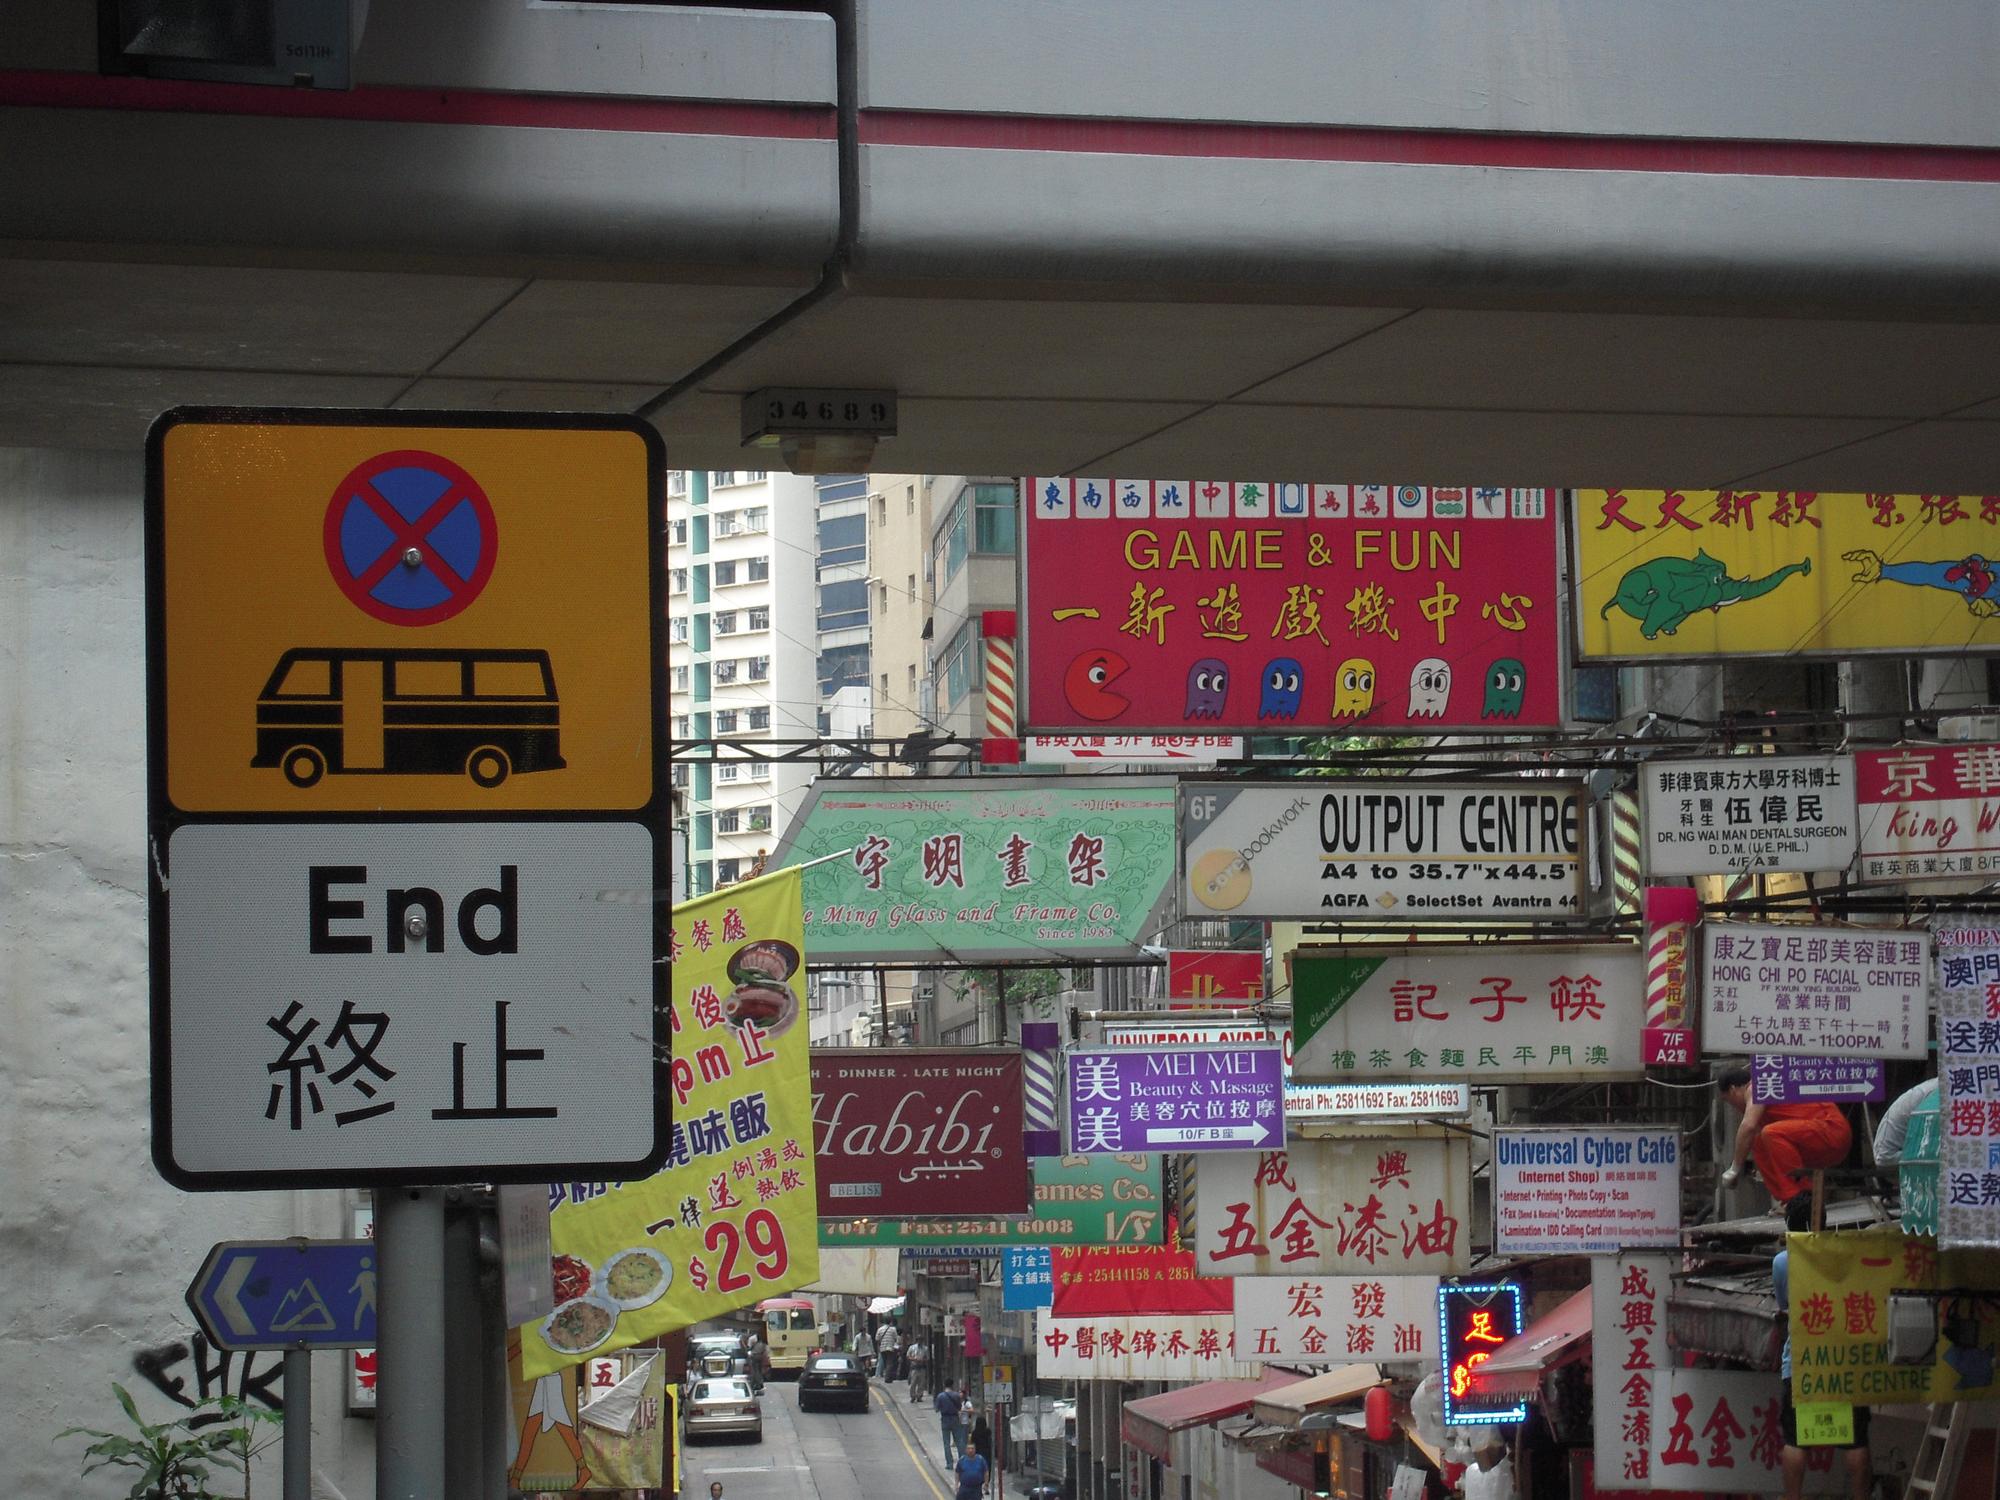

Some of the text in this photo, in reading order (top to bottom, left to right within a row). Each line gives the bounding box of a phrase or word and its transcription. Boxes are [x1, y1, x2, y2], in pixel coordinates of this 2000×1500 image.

[286, 44, 334, 58] HILIPS
[769, 401, 887, 423] 34689
[1124, 529, 1462, 571] GAME & FUN
[1051, 581, 1535, 647] 一新遊戲機中心
[1660, 768, 1841, 793] 菲律賓東方大學牙科博士
[1190, 795, 1216, 820] 6F
[1725, 794, 1823, 826] 伍偉民
[1320, 793, 1579, 853] OUTPUT CENTRE
[1658, 826, 1847, 843] DR. NG WAI MAN DENTAL SURGEON
[1886, 803, 1959, 849] King
[1322, 863, 1357, 880] A4
[1371, 864, 1398, 880] to
[1870, 856, 1973, 876] 群英商業大廈
[309, 865, 518, 955] End
[1322, 894, 1370, 908] AGFA
[1407, 893, 1482, 908] SelectSet
[1493, 894, 1551, 908] Avantra
[822, 905, 879, 928] Ming
[890, 904, 947, 925] Glass
[956, 902, 998, 922] and
[1014, 904, 1078, 922] Frame
[1087, 903, 1121, 921] Co.
[1037, 926, 1114, 940] Since 1983
[1714, 935, 1921, 965] 康之寶足部美容護理
[1712, 965, 1921, 987] HONG CHI PO FACIAL CENTER
[1775, 994, 1850, 1012] 營業時間
[1735, 1015, 1890, 1034] 上午九時至下午十一時
[1663, 1032, 1684, 1046] 7/F
[1741, 1031, 1884, 1049] 9:00A.M. 11:00P.M.
[265, 1000, 558, 1130] 終止
[839, 1068, 896, 1078] DINNER
[914, 1068, 949, 1078] LATE
[957, 1067, 1004, 1077] NIGHT
[1145, 1052, 1257, 1076] MEI MEI
[1130, 1082, 1185, 1098] Beauty
[1190, 1081, 1203, 1095] &
[1210, 1079, 1274, 1097] Massage
[1129, 1099, 1276, 1122] 美容穴位按摩
[1317, 1093, 1332, 1110] Ph:
[1387, 1091, 1407, 1107] Fax:
[811, 1090, 1000, 1156] Habibi
[1178, 1130, 1206, 1140] 10/F
[1499, 1135, 1676, 1167] Universal Cyber Café
[1518, 1170, 1565, 1183] (Internet
[1569, 1170, 1600, 1184] Shop)
[1112, 1178, 1156, 1201] Co.
[1503, 1188, 1629, 1204] Internet Printing Photo Copy Scan
[1504, 1207, 1516, 1219] Fax
[1565, 1206, 1616, 1218] Documentation
[899, 1220, 953, 1235] Fax:
[957, 1220, 1008, 1235] 2541
[1017, 1218, 1074, 1235] 6008
[1210, 1194, 1457, 1265] 五金漆油
[1504, 1224, 1542, 1237] Lamination
[1561, 1223, 1585, 1239] Calling
[1586, 1223, 1602, 1236] Card
[1288, 1282, 1386, 1319] 宏發
[1252, 1323, 1422, 1355] 五金漆油
[591, 1362, 616, 1387] 五
[1619, 1265, 1657, 1480] 成興五金漆油
[1801, 1369, 1931, 1395] GAME CENTRE
